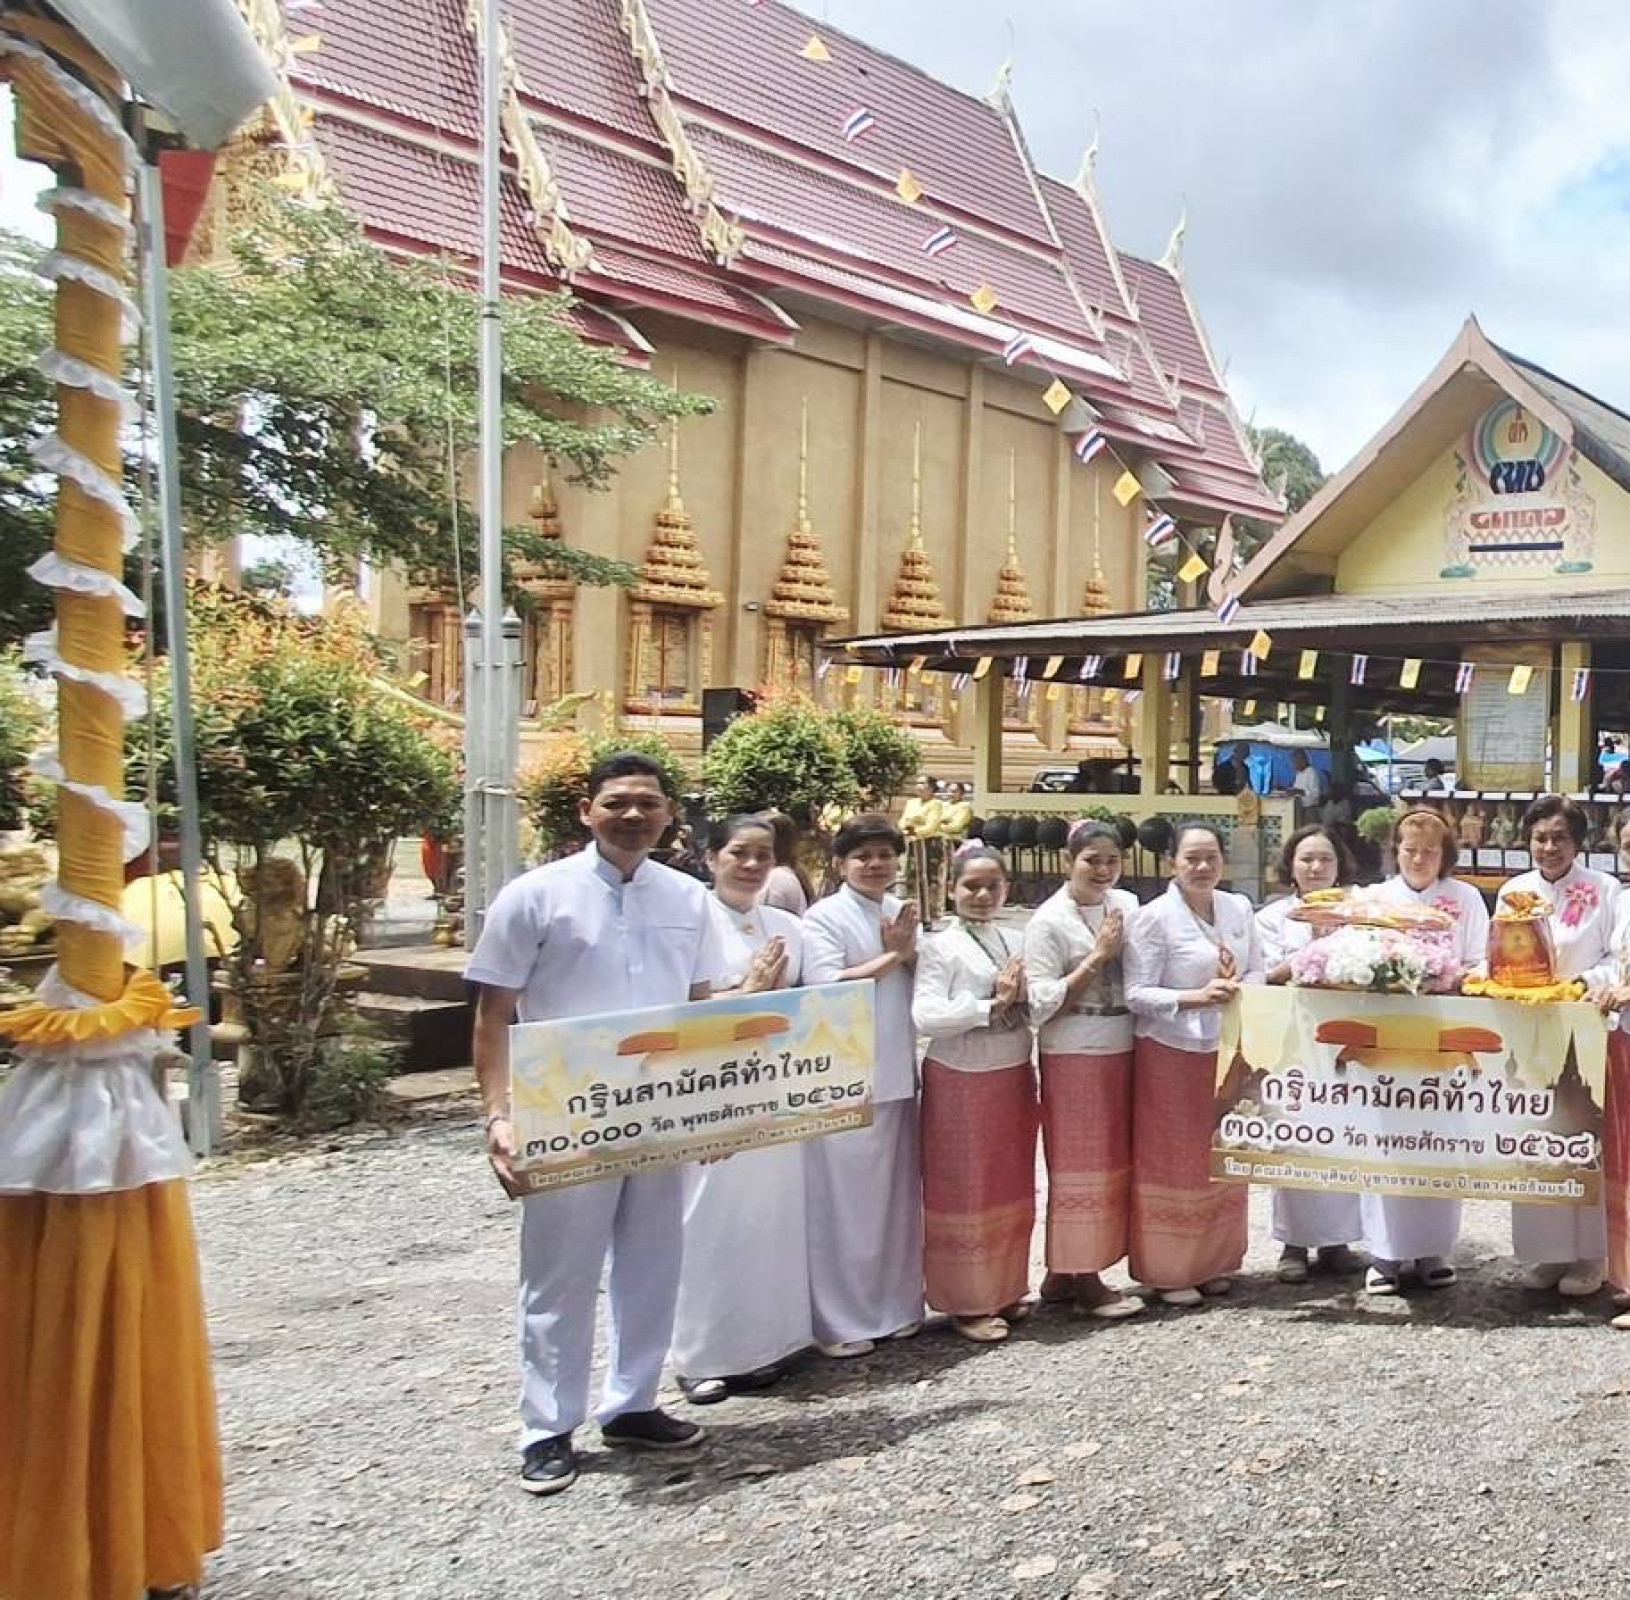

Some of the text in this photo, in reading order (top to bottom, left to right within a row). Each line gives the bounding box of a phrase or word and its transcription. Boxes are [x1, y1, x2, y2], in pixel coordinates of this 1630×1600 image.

[567, 1051, 832, 1119] กฐินสามัคคีทั่วไทย
[1264, 1069, 1552, 1117] กฐินสามัคคีทั่วไทย
[525, 1121, 643, 1157] ๓๐,๐๐๐
[650, 1114, 676, 1134] วัด
[786, 1080, 866, 1107] ๒๕๖๘
[1222, 1115, 1595, 1160] ๓๐,๐๐๐ วัด พุทธศักราช ๒๕๖๘
